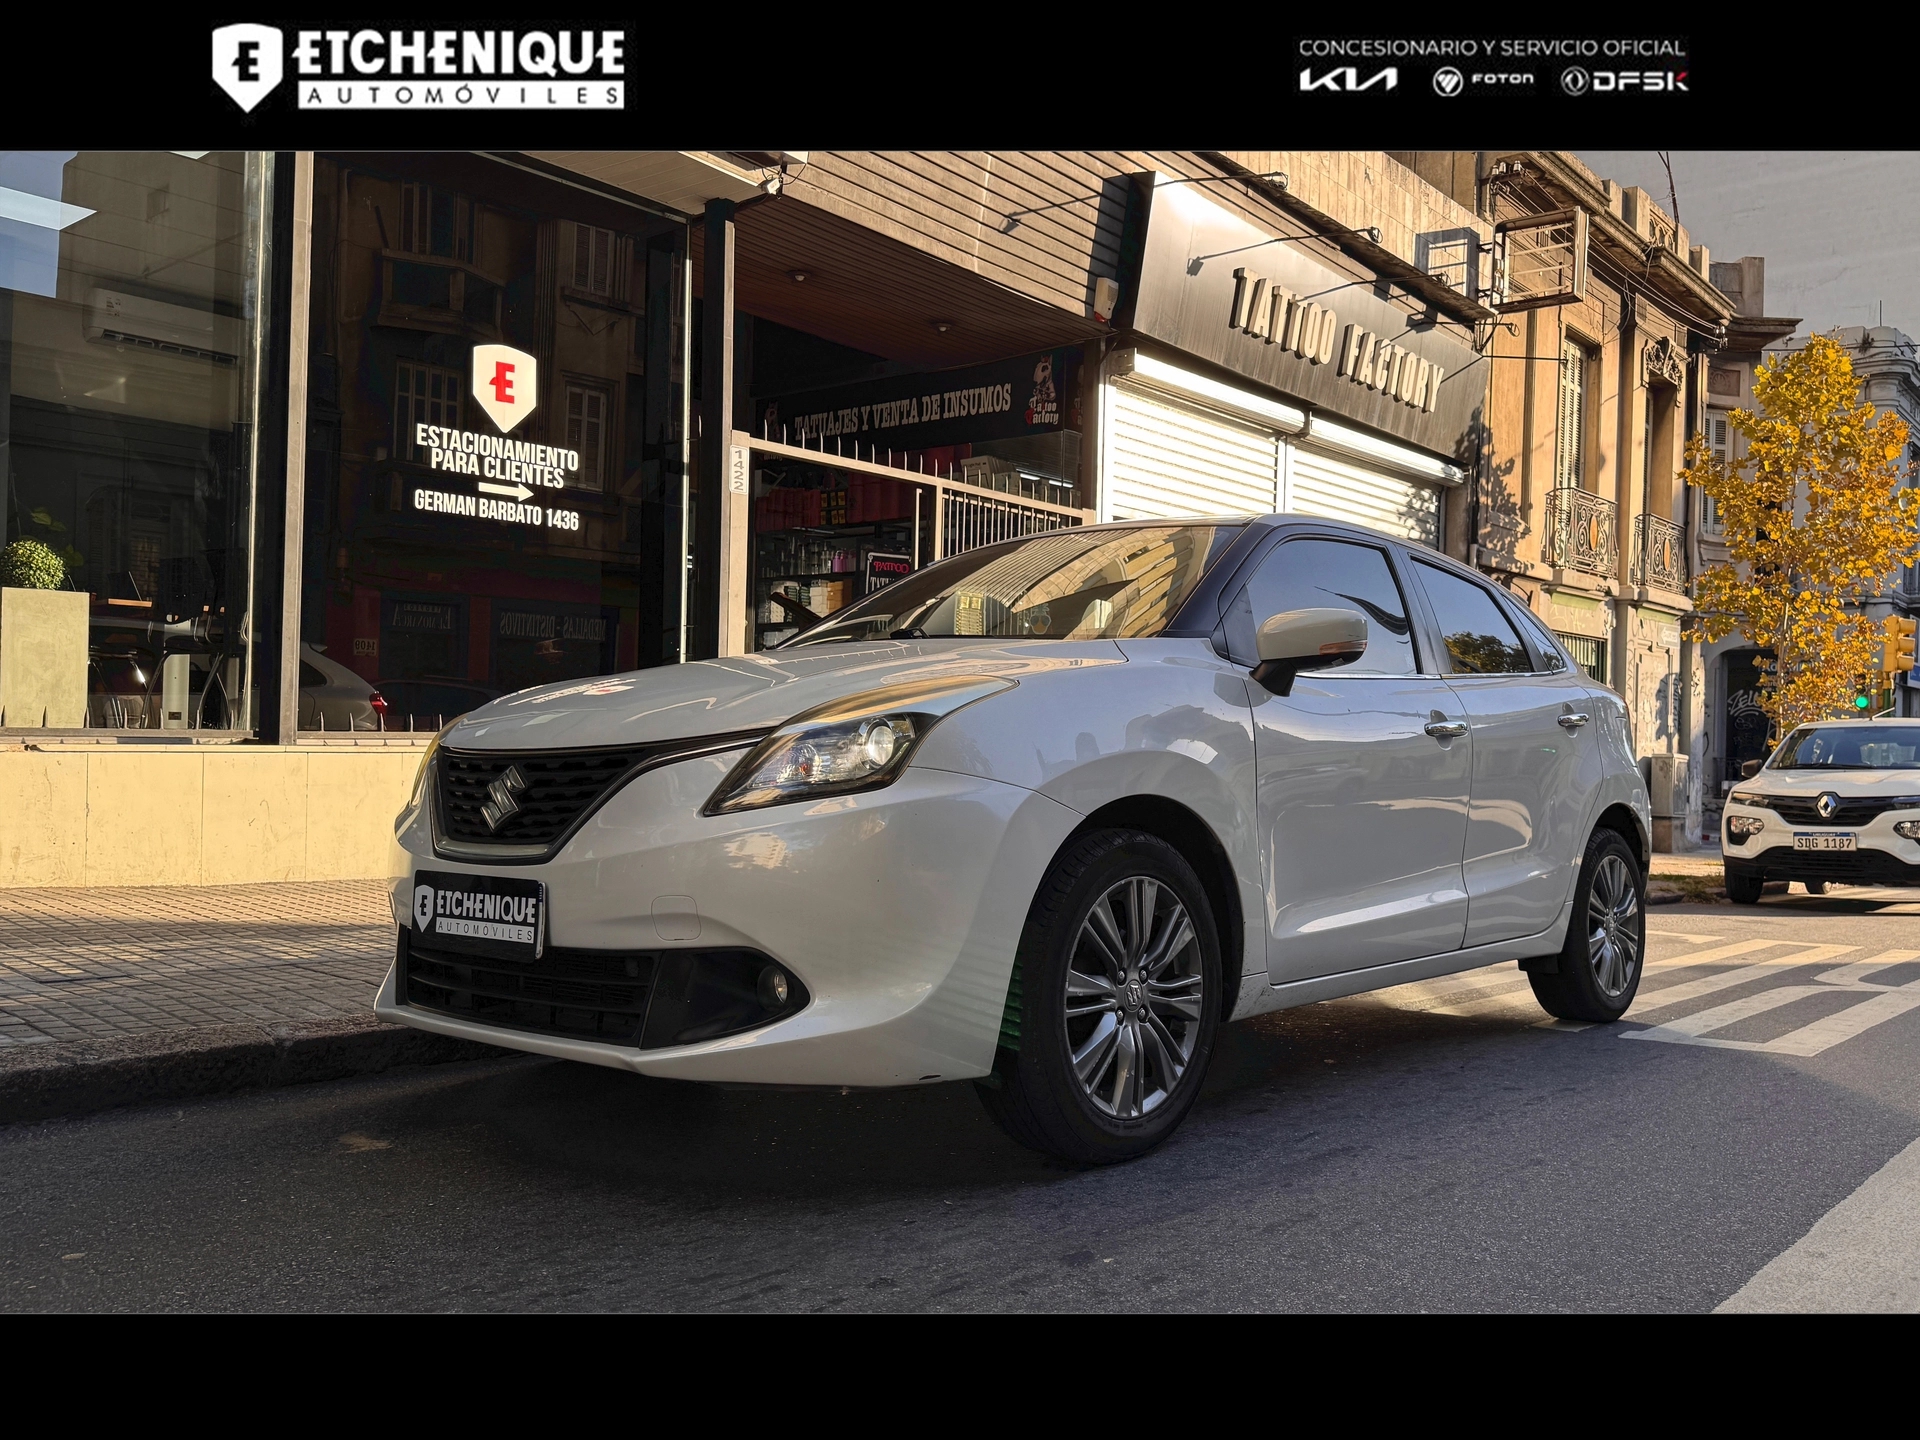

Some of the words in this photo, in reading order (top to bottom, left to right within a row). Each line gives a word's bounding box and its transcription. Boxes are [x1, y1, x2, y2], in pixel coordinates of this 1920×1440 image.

[1231, 267, 1337, 366] TATTOO
[1339, 323, 1445, 413] FACTORY
[794, 408, 858, 442] TATUAJES
[859, 405, 872, 431] Y
[871, 398, 919, 430] VENTA
[921, 394, 941, 423] DE
[943, 383, 1012, 419] INSUMOS
[416, 423, 579, 471] ESTACIONAMIENTO
[431, 447, 479, 476] PARA
[484, 457, 564, 489] CLIENTES
[733, 449, 745, 492] 1422
[414, 489, 476, 517] GERMAN
[479, 498, 542, 525] BARBATO
[546, 509, 579, 531] 1436
[873, 561, 911, 575] TATTOO
[1797, 837, 1819, 849] SDG
[1824, 838, 1852, 849] 1187
[436, 890, 536, 923] ETCHENIQUE
[438, 921, 533, 941] AUTOMÓVILES
